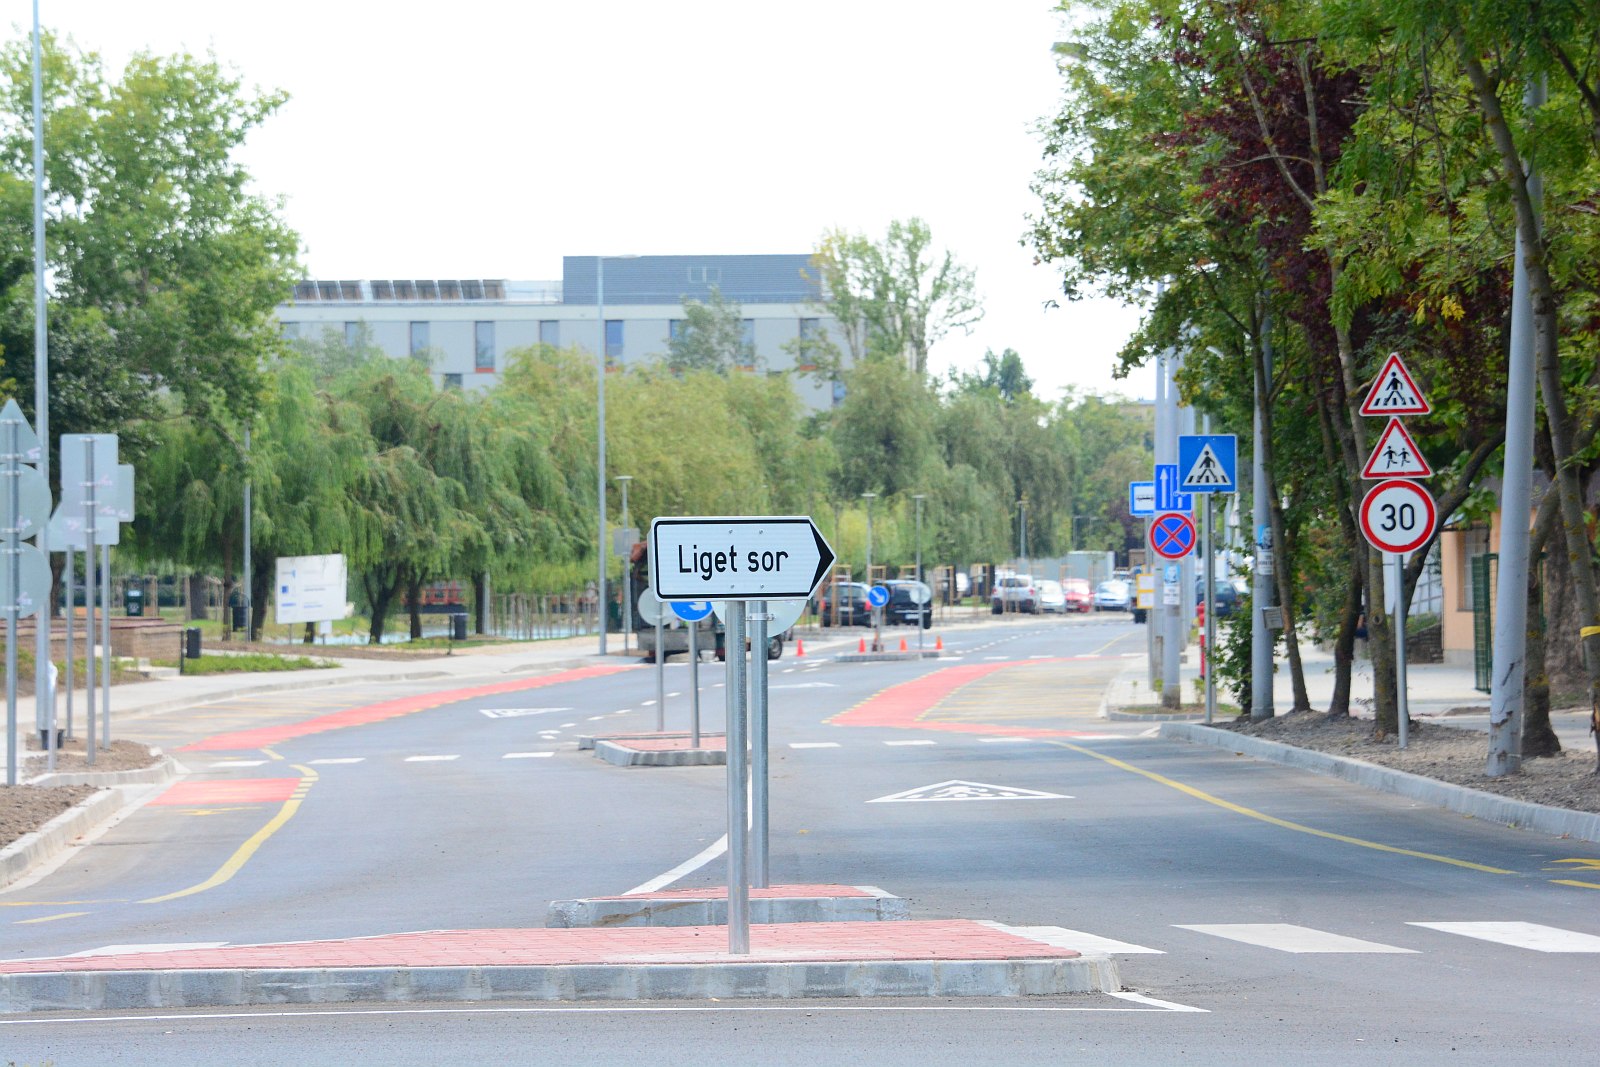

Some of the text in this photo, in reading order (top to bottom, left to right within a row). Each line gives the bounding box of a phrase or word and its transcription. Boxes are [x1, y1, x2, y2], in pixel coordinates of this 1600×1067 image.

[1380, 503, 1415, 531] 30
[678, 544, 789, 581] Liget sor
